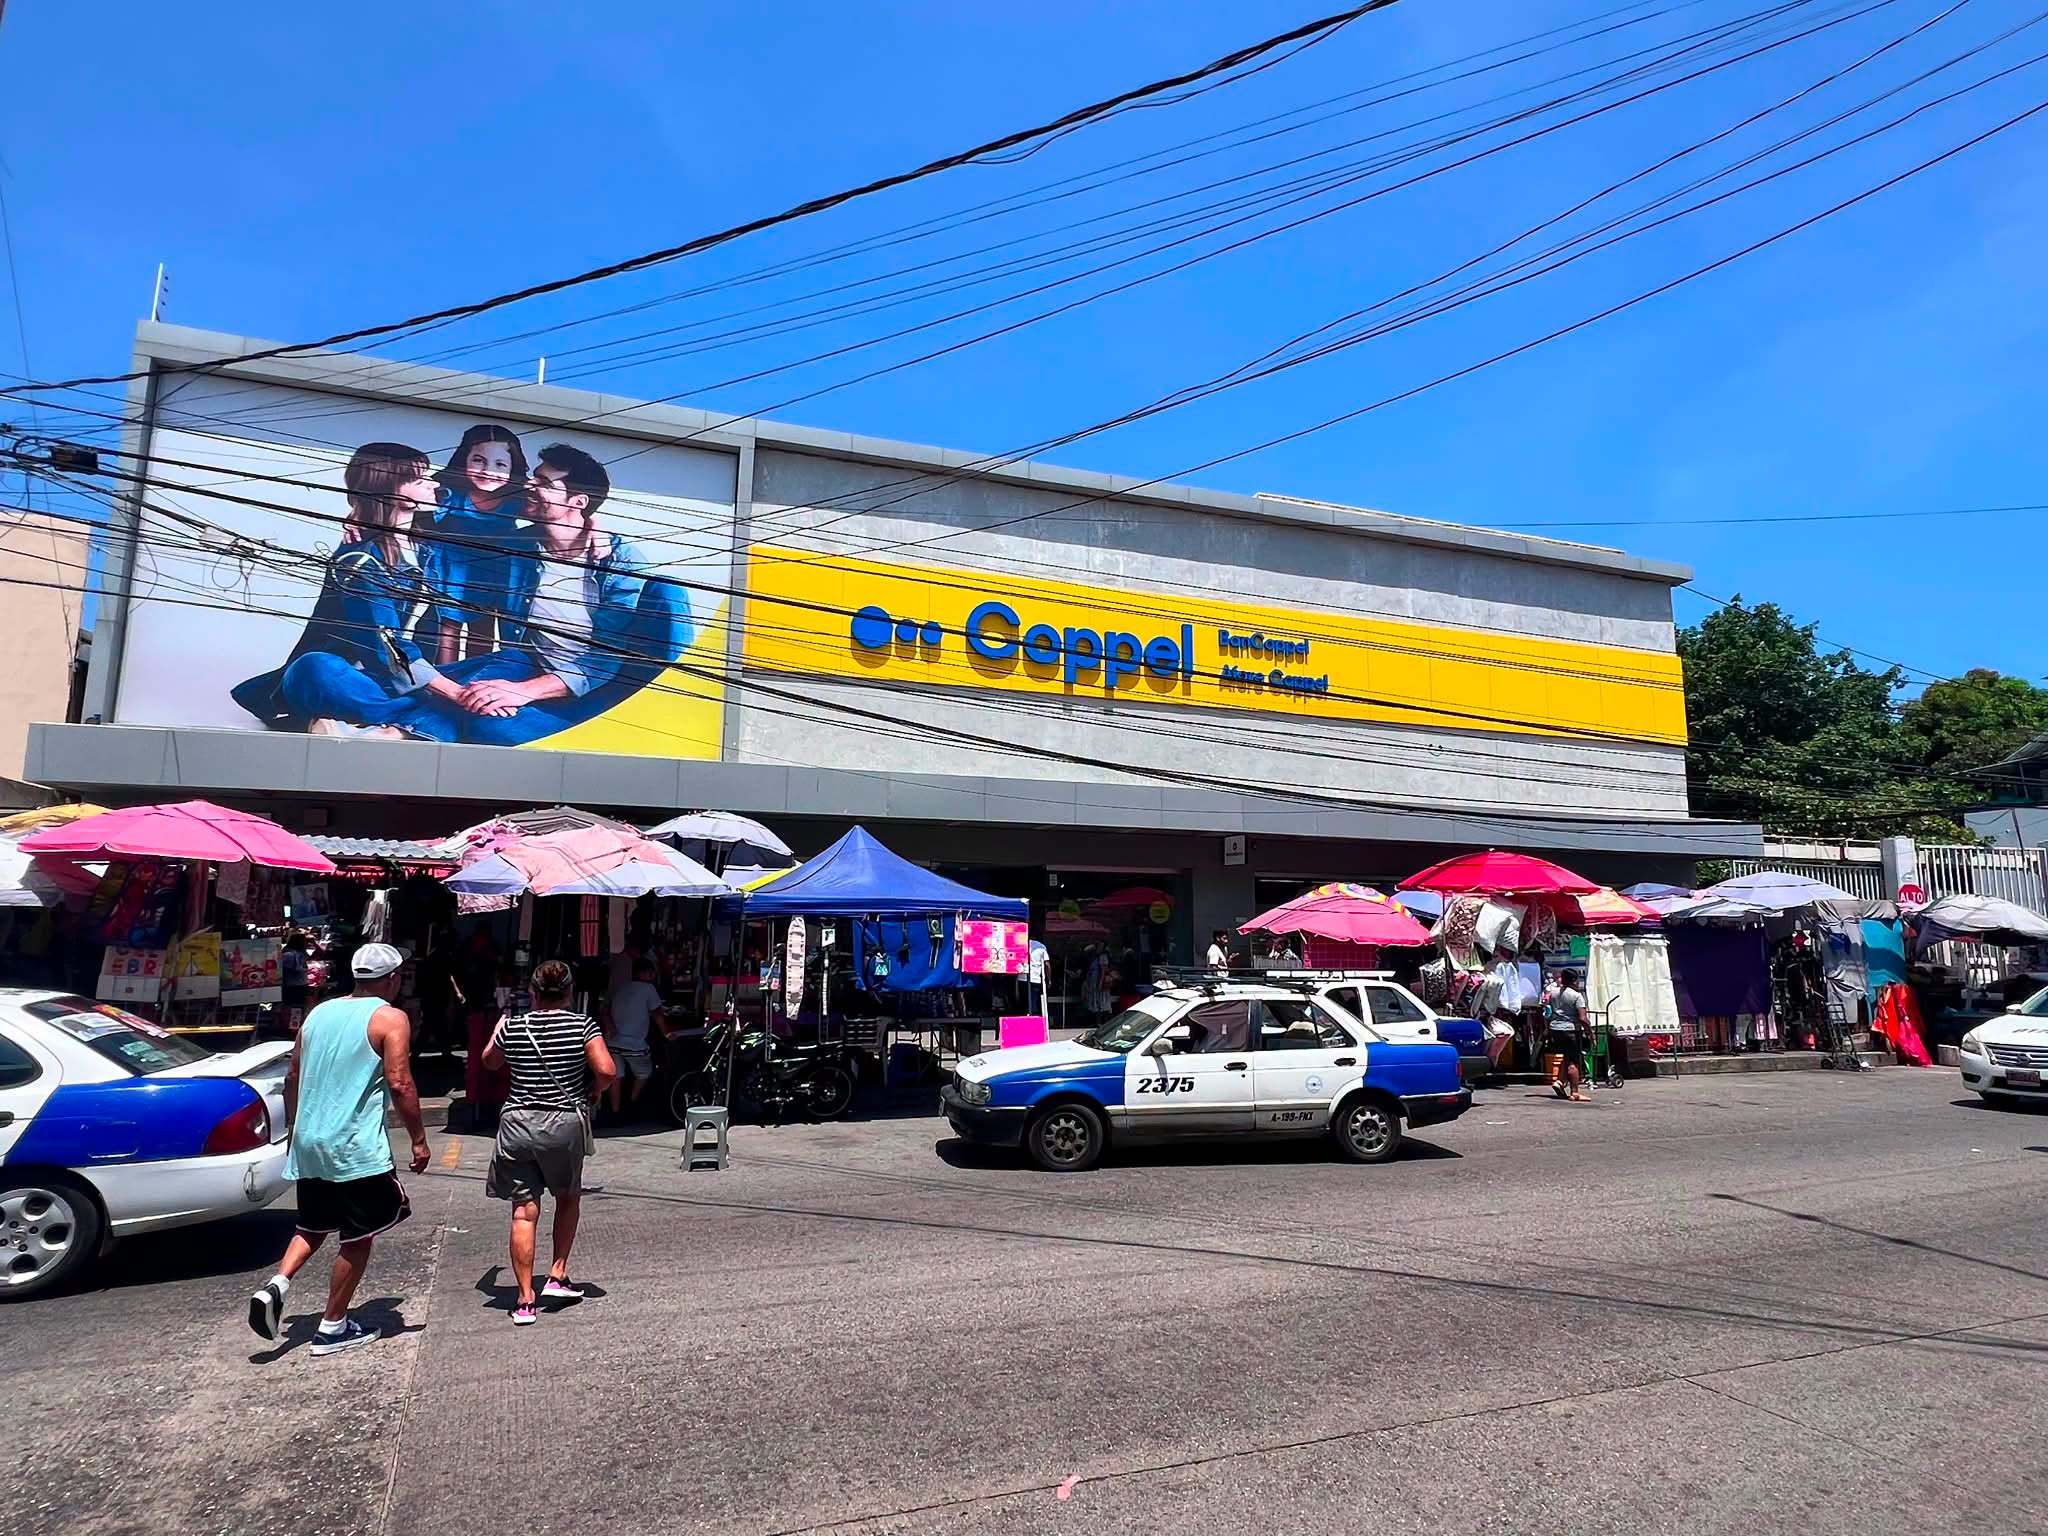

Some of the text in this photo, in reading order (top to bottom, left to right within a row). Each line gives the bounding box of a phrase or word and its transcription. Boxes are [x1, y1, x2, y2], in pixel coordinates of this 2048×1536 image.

[966, 601, 1194, 688] Coppel
[1218, 629, 1309, 657] BanCoppel
[1269, 669, 1329, 693] Coppel
[1900, 891, 1923, 903] ALTO
[1136, 1077, 1195, 1094] 2375
